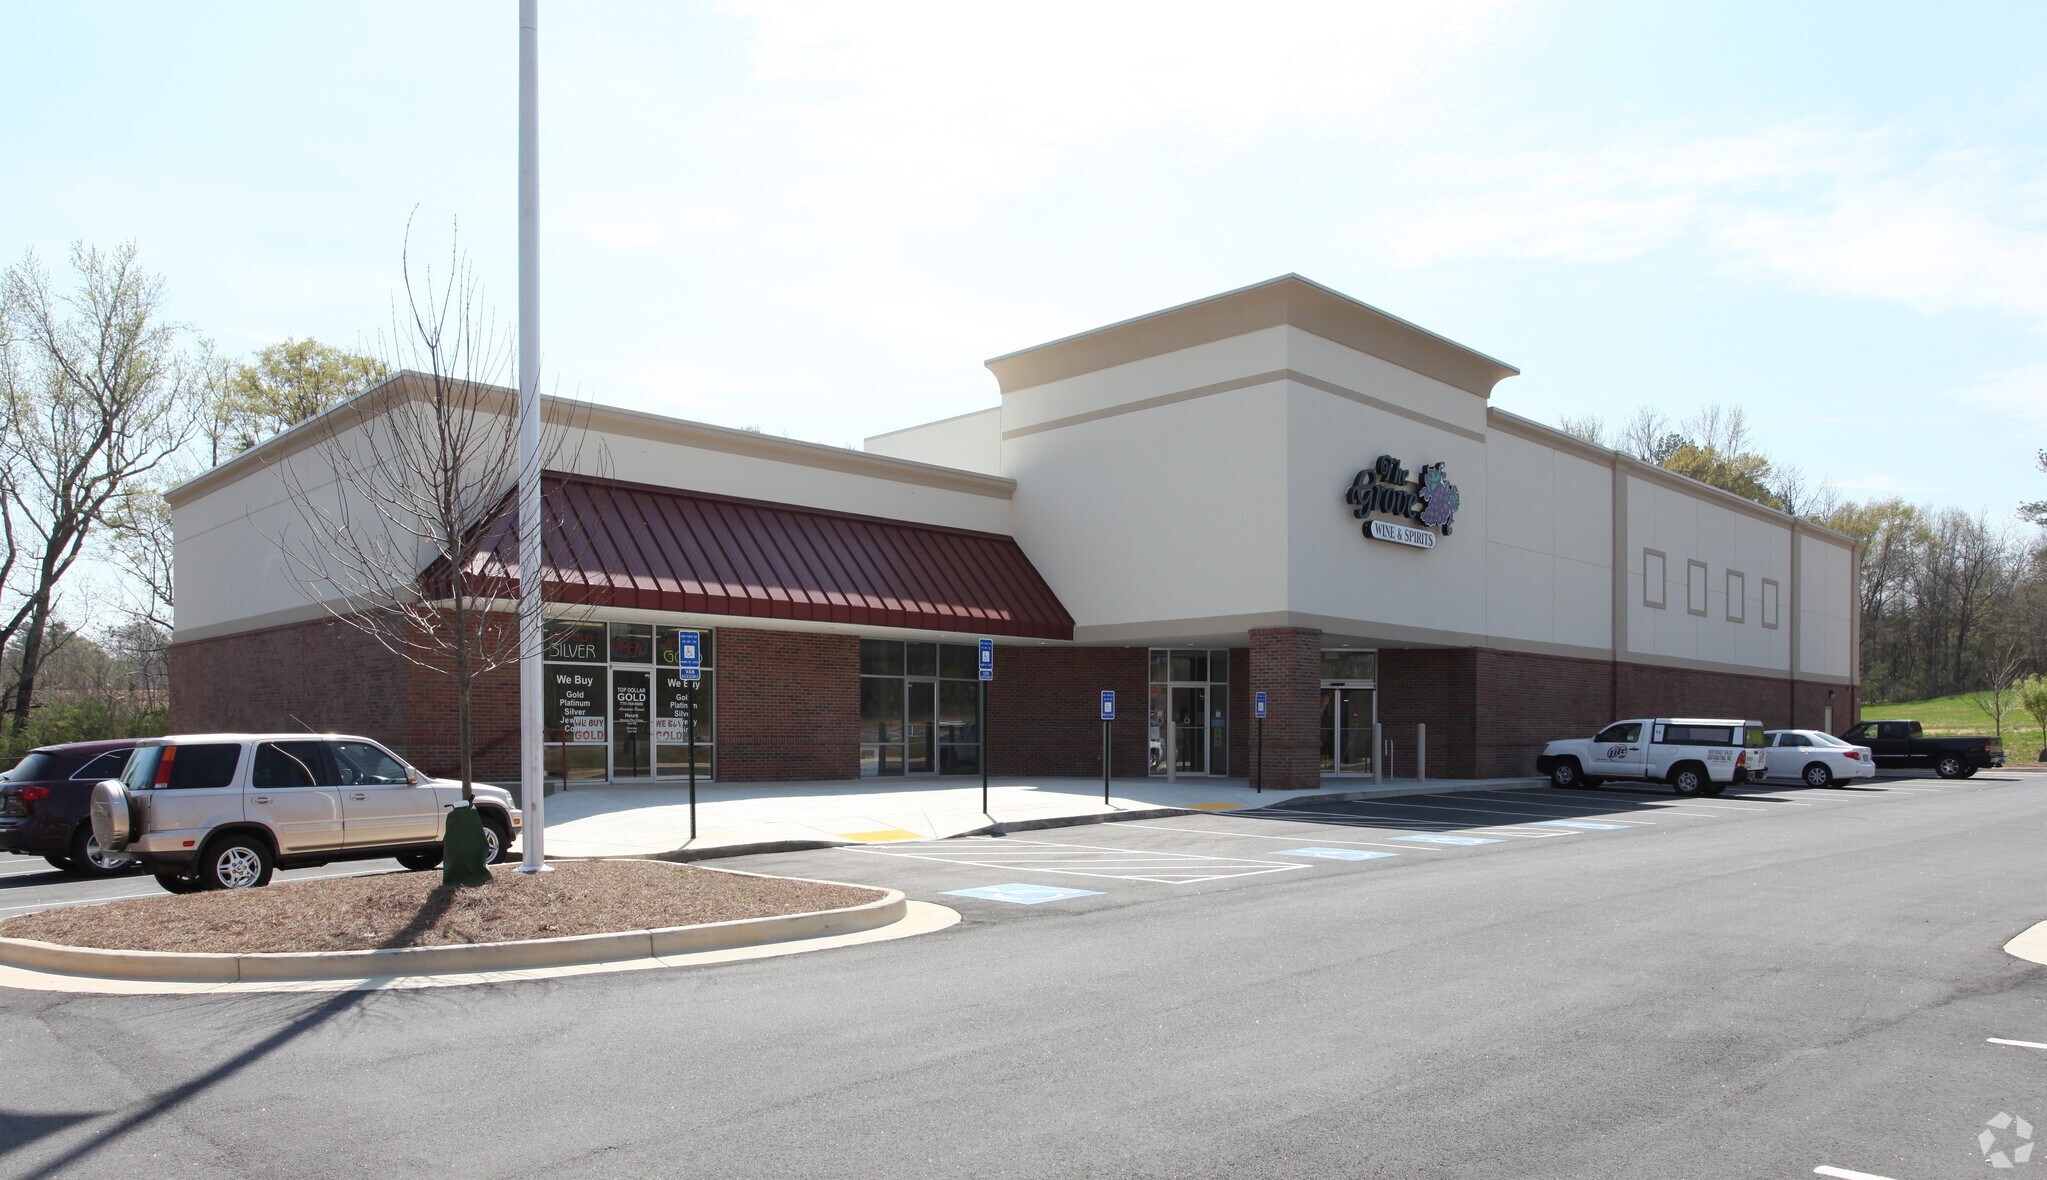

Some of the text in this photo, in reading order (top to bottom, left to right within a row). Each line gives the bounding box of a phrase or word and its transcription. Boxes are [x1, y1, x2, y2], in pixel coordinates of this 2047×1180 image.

[1376, 454, 1409, 486] The
[1346, 468, 1420, 519] Grove
[1374, 522, 1434, 547] WINE & SPIRITS
[550, 643, 596, 658] SILVER
[556, 675, 593, 687] We Buy
[667, 678, 701, 691] We By
[566, 690, 585, 699] Gold
[617, 693, 646, 702] GOLD
[675, 693, 689, 701] Gol
[559, 698, 591, 707] Platinum
[670, 701, 698, 709] Platinm
[564, 708, 586, 716] Silver
[674, 709, 689, 717] Silv
[588, 719, 604, 727] BUY
[656, 719, 667, 728] WE
[574, 730, 604, 740] GOLD
[656, 730, 683, 741] GOLD
